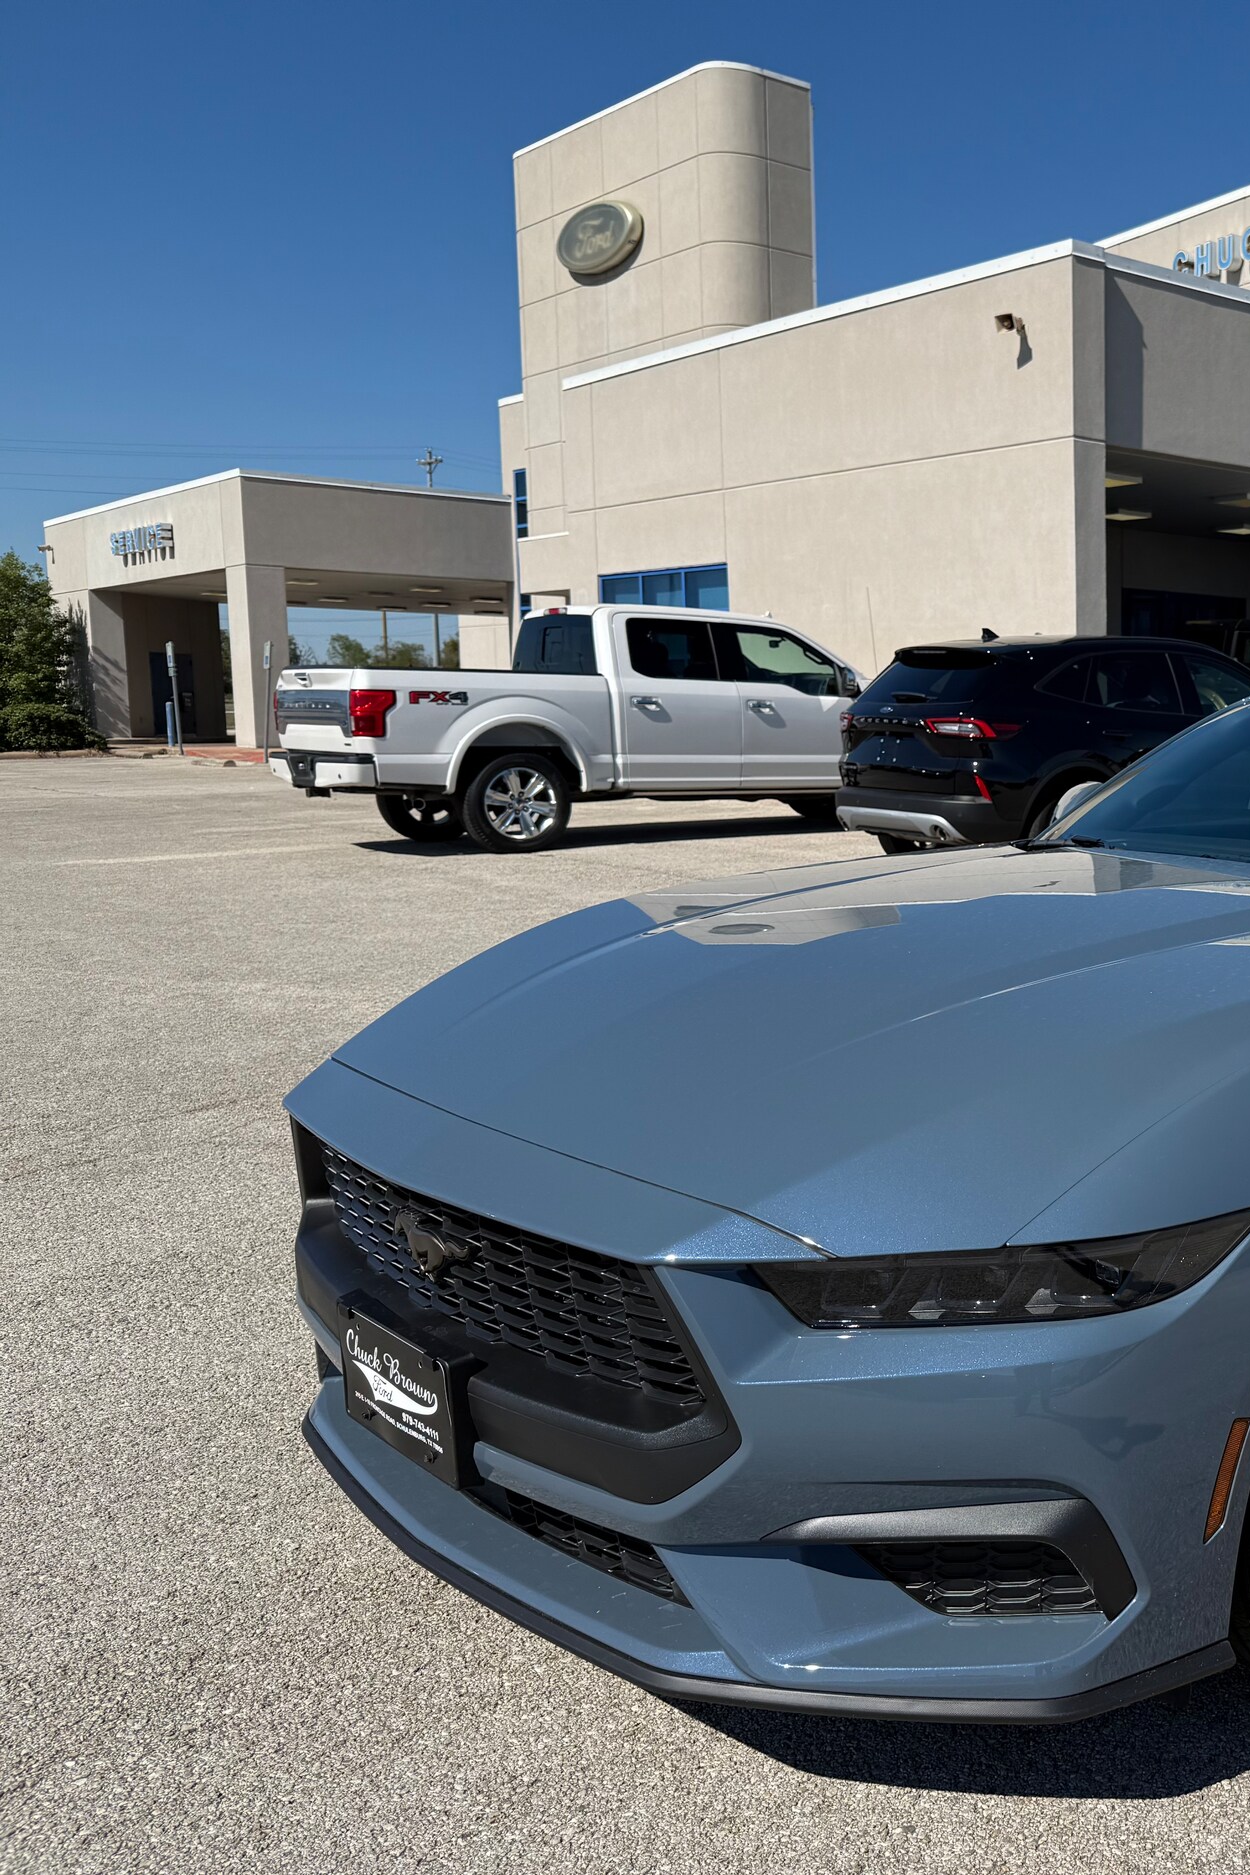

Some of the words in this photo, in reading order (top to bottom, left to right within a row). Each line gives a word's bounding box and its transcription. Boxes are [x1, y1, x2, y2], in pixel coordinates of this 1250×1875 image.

[575, 217, 615, 259] Ford
[110, 522, 168, 556] SERVICE
[408, 690, 469, 704] FX4
[346, 1328, 383, 1372] Chuck
[383, 1352, 438, 1405] Brown
[372, 1374, 393, 1402] Ford
